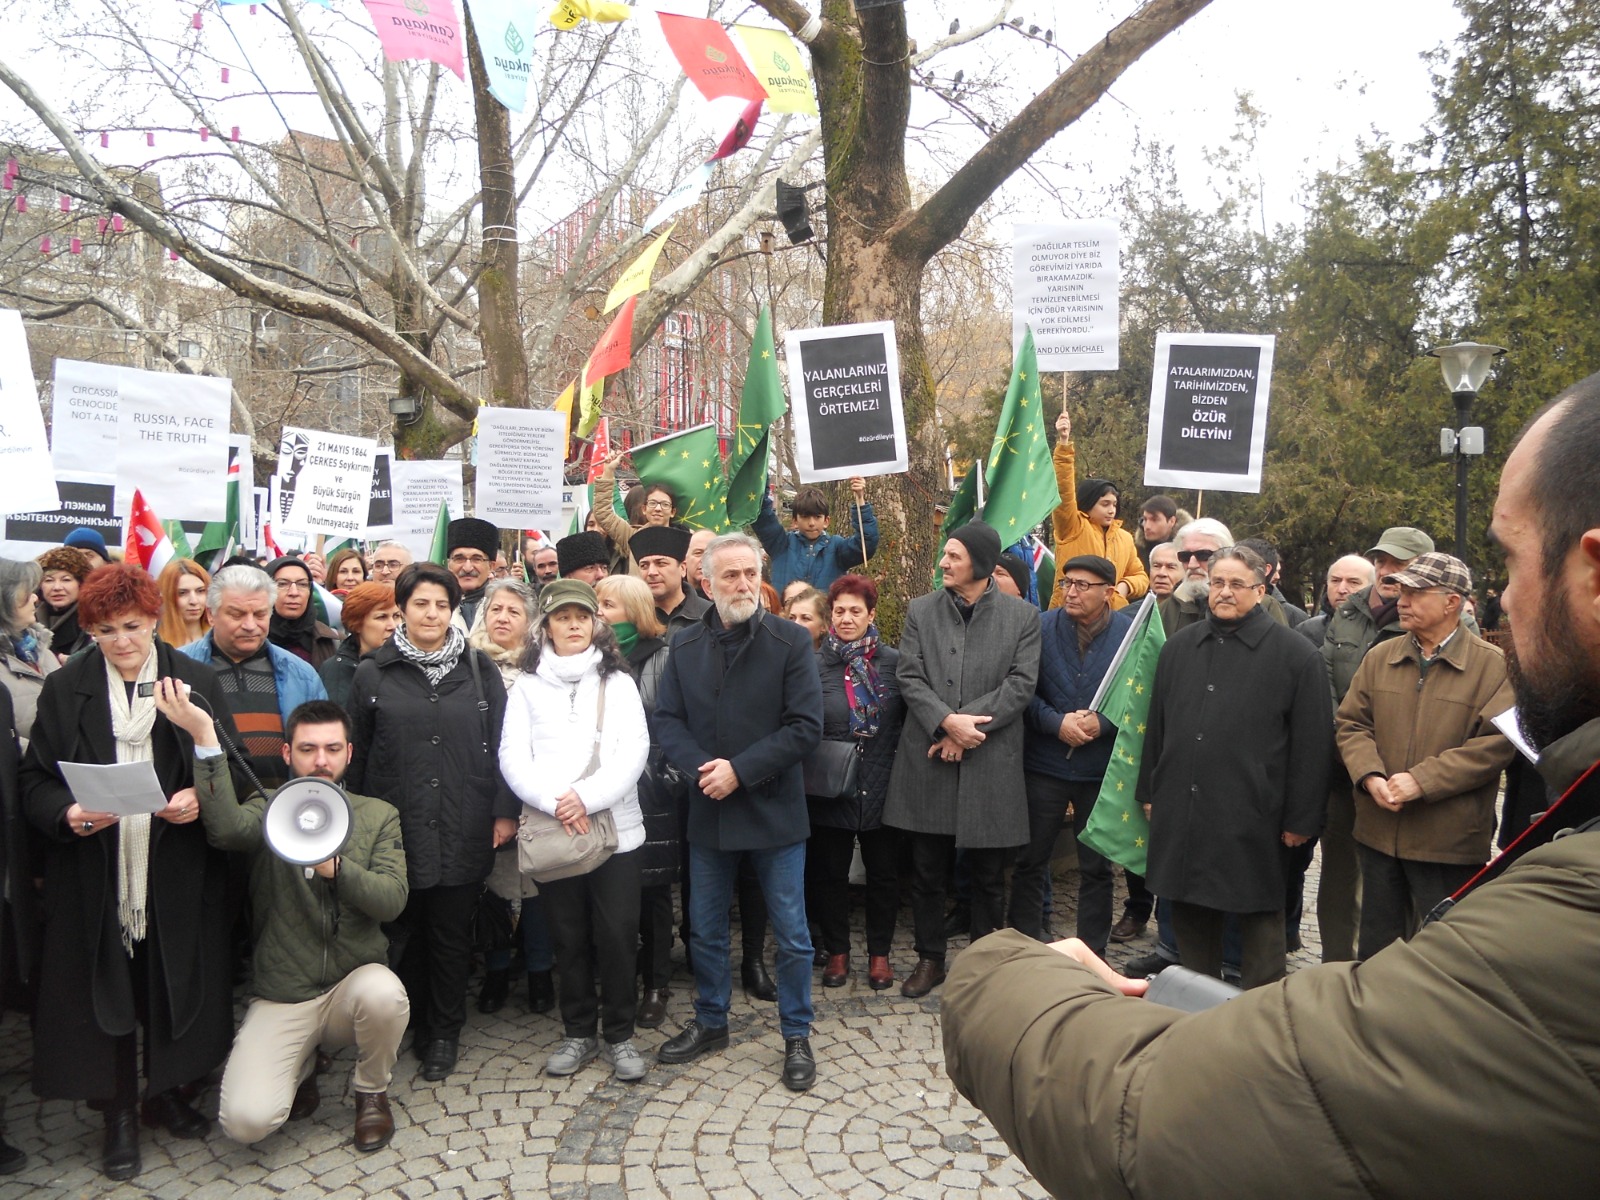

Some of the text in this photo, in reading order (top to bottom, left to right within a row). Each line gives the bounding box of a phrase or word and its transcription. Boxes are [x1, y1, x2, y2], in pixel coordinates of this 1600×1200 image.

[1073, 240, 1100, 249] TESLİM
[1031, 251, 1101, 262] OLMUYOR DİYE BİZ
[1029, 262, 1102, 272] GÖREVİMİZİ YARIDA
[1036, 273, 1095, 283] BIRAKAMAZDIK.
[1047, 284, 1084, 293] YARISININ
[1031, 294, 1100, 304] TEMİZLENEBİLMESİ
[1028, 304, 1104, 315] İÇİN ÖBÜR YARISININ
[1057, 315, 1091, 324] EDİLMESİ
[1037, 346, 1053, 354] AND
[1054, 345, 1070, 354] DÜK
[804, 363, 888, 382] YALANLARINIZ
[1170, 366, 1255, 380] ATALARIMIZDAN,
[72, 385, 118, 398] CIRCASSIA
[813, 379, 882, 399] GERÇEKLERİ
[1173, 379, 1249, 394] TARİHİMİZDEN,
[69, 398, 118, 411] GENOCIDE
[1191, 393, 1228, 406] BİZDEN
[819, 398, 880, 416] ÖRTEMEZ!
[71, 410, 92, 420] NOT
[93, 412, 101, 421] A
[133, 412, 214, 429] RUSSIA, FACE
[1192, 408, 1227, 424] ÖZÜR
[139, 429, 207, 444] THE TRUTH
[1181, 424, 1232, 441] DİLEYİN!
[317, 442, 368, 457] 21 MAYIS 1864
[309, 455, 338, 467] ÇERKES
[338, 459, 372, 474] Soykırımı
[335, 476, 343, 484] ve
[312, 485, 361, 502] Büyük Sürgün
[64, 501, 106, 512] ПЭЖЫМ
[316, 501, 354, 515] Unutmadık
[307, 514, 359, 532] Unutmayacağız
